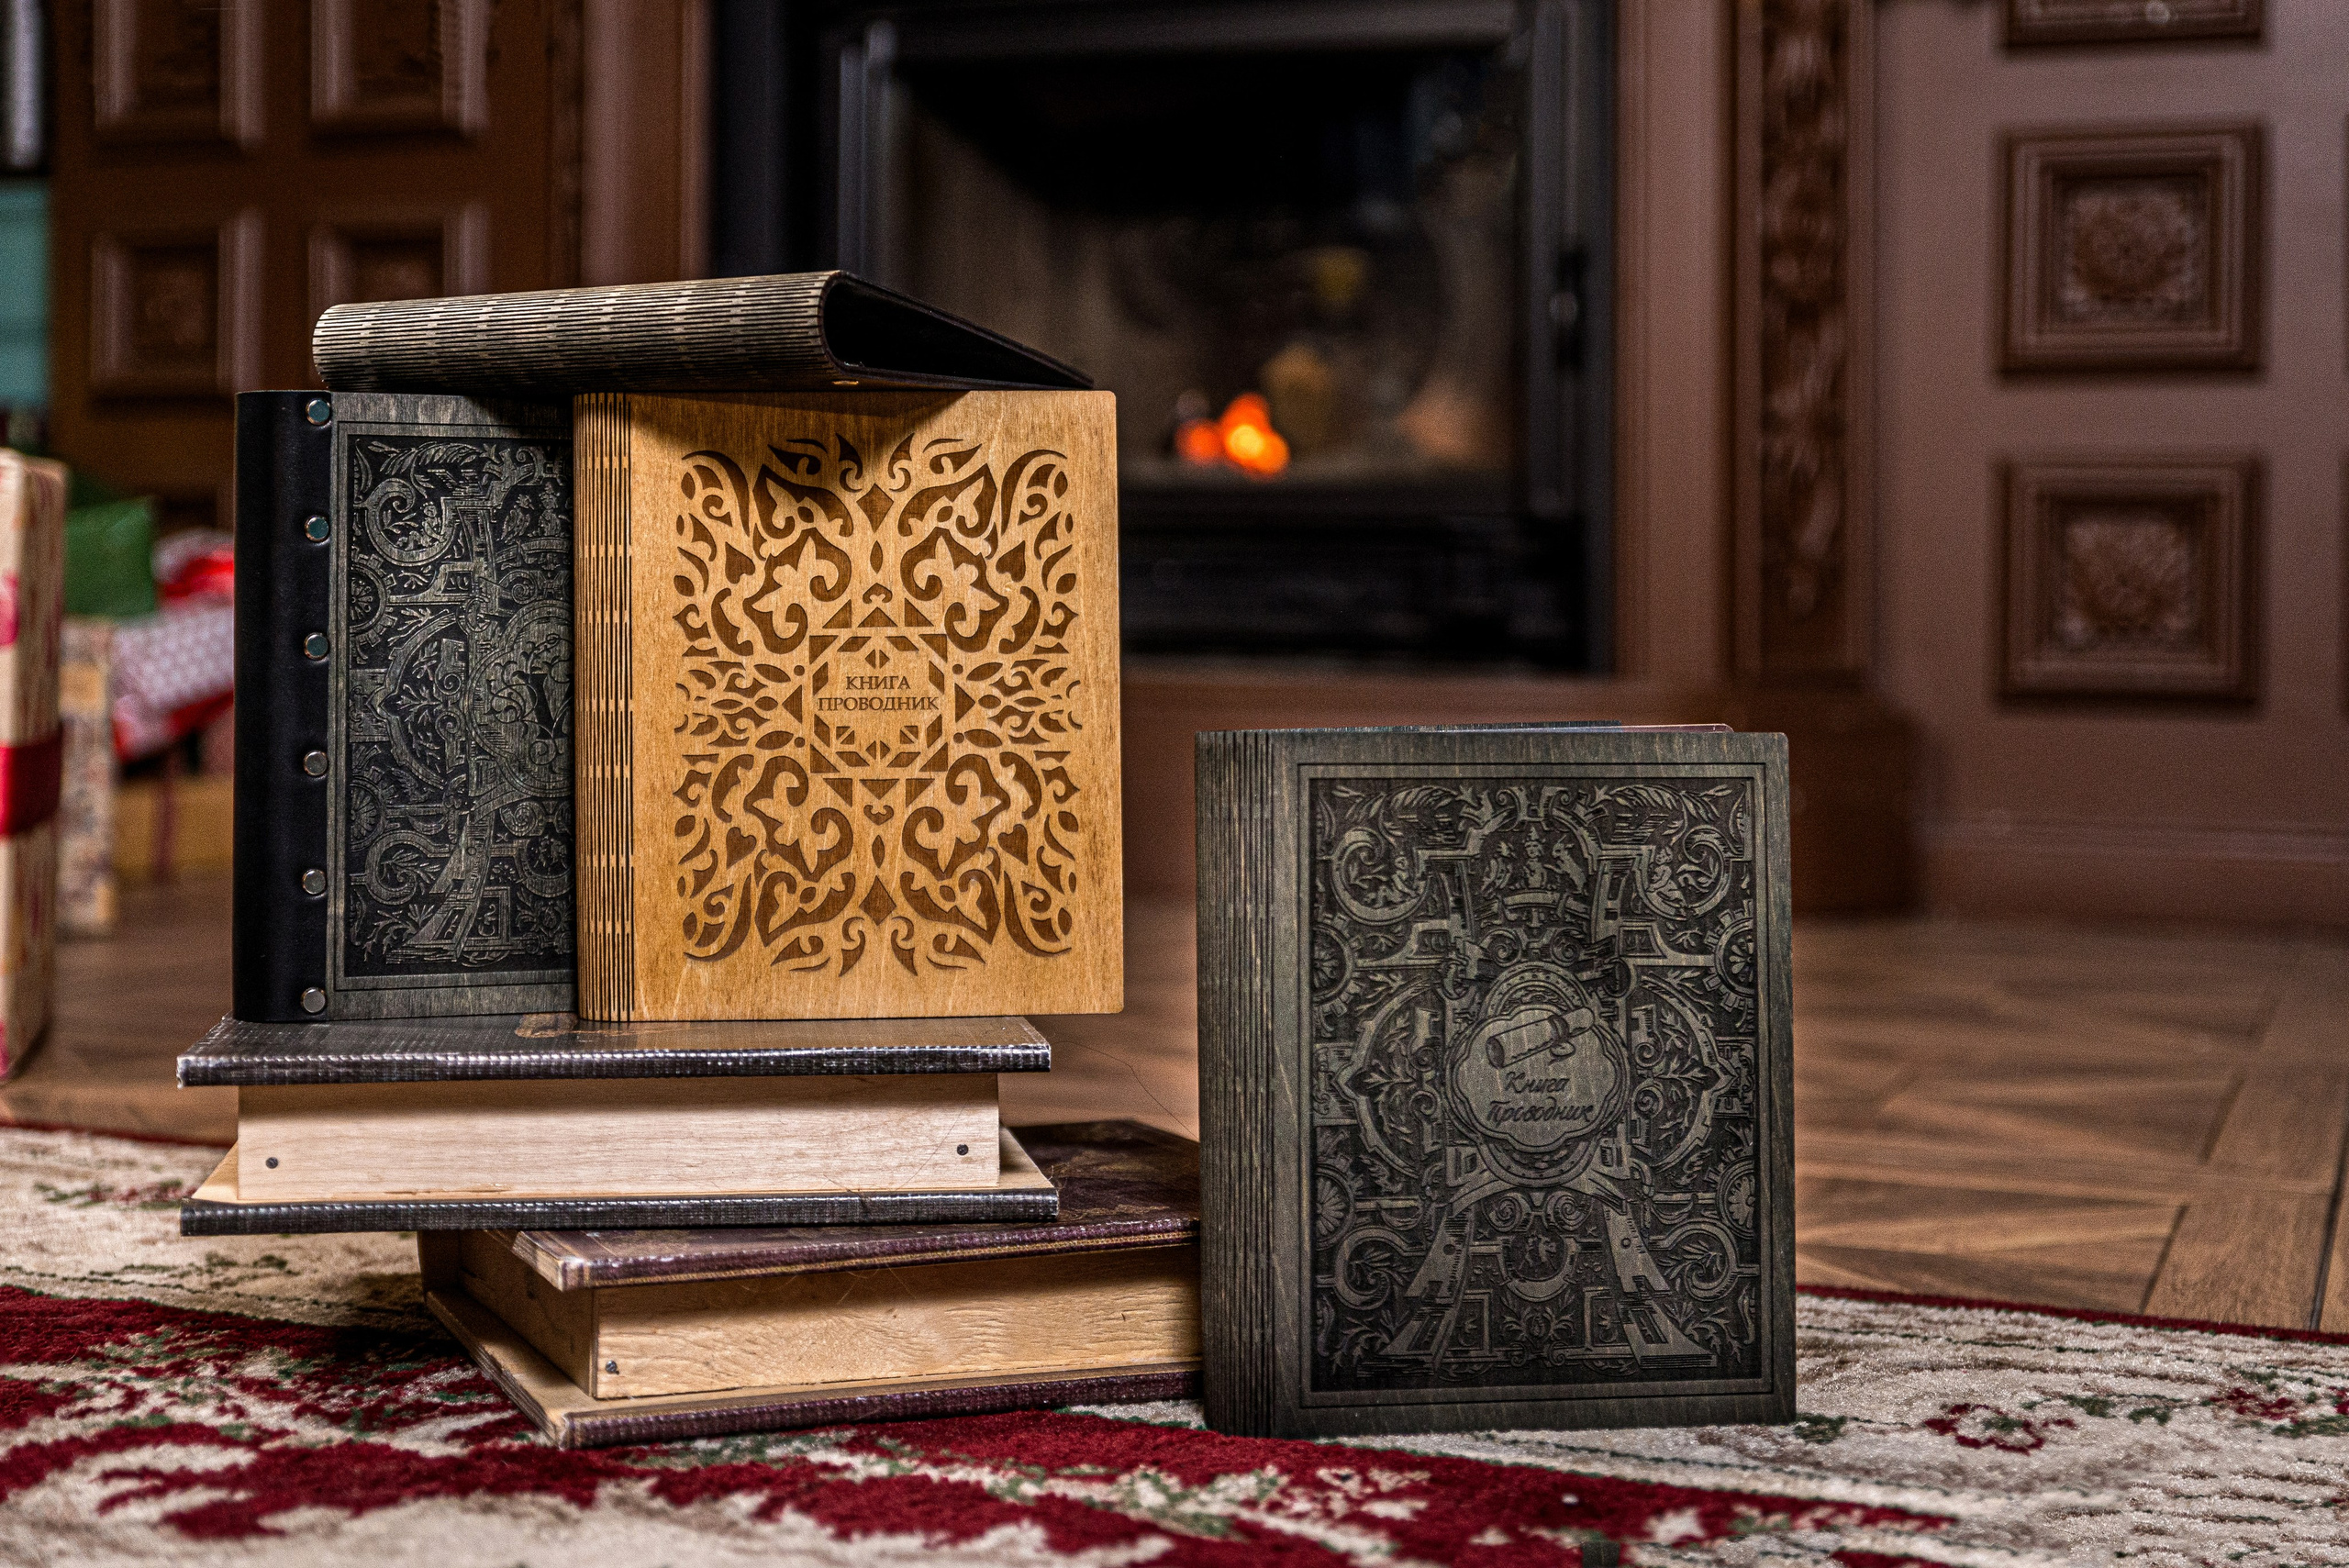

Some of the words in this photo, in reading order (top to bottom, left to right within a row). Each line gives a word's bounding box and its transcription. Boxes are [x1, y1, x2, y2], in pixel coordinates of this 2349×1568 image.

[845, 675, 911, 690] КНИГА
[818, 696, 940, 713] ПРОВОДНИК
[1505, 1071, 1570, 1095] Книга
